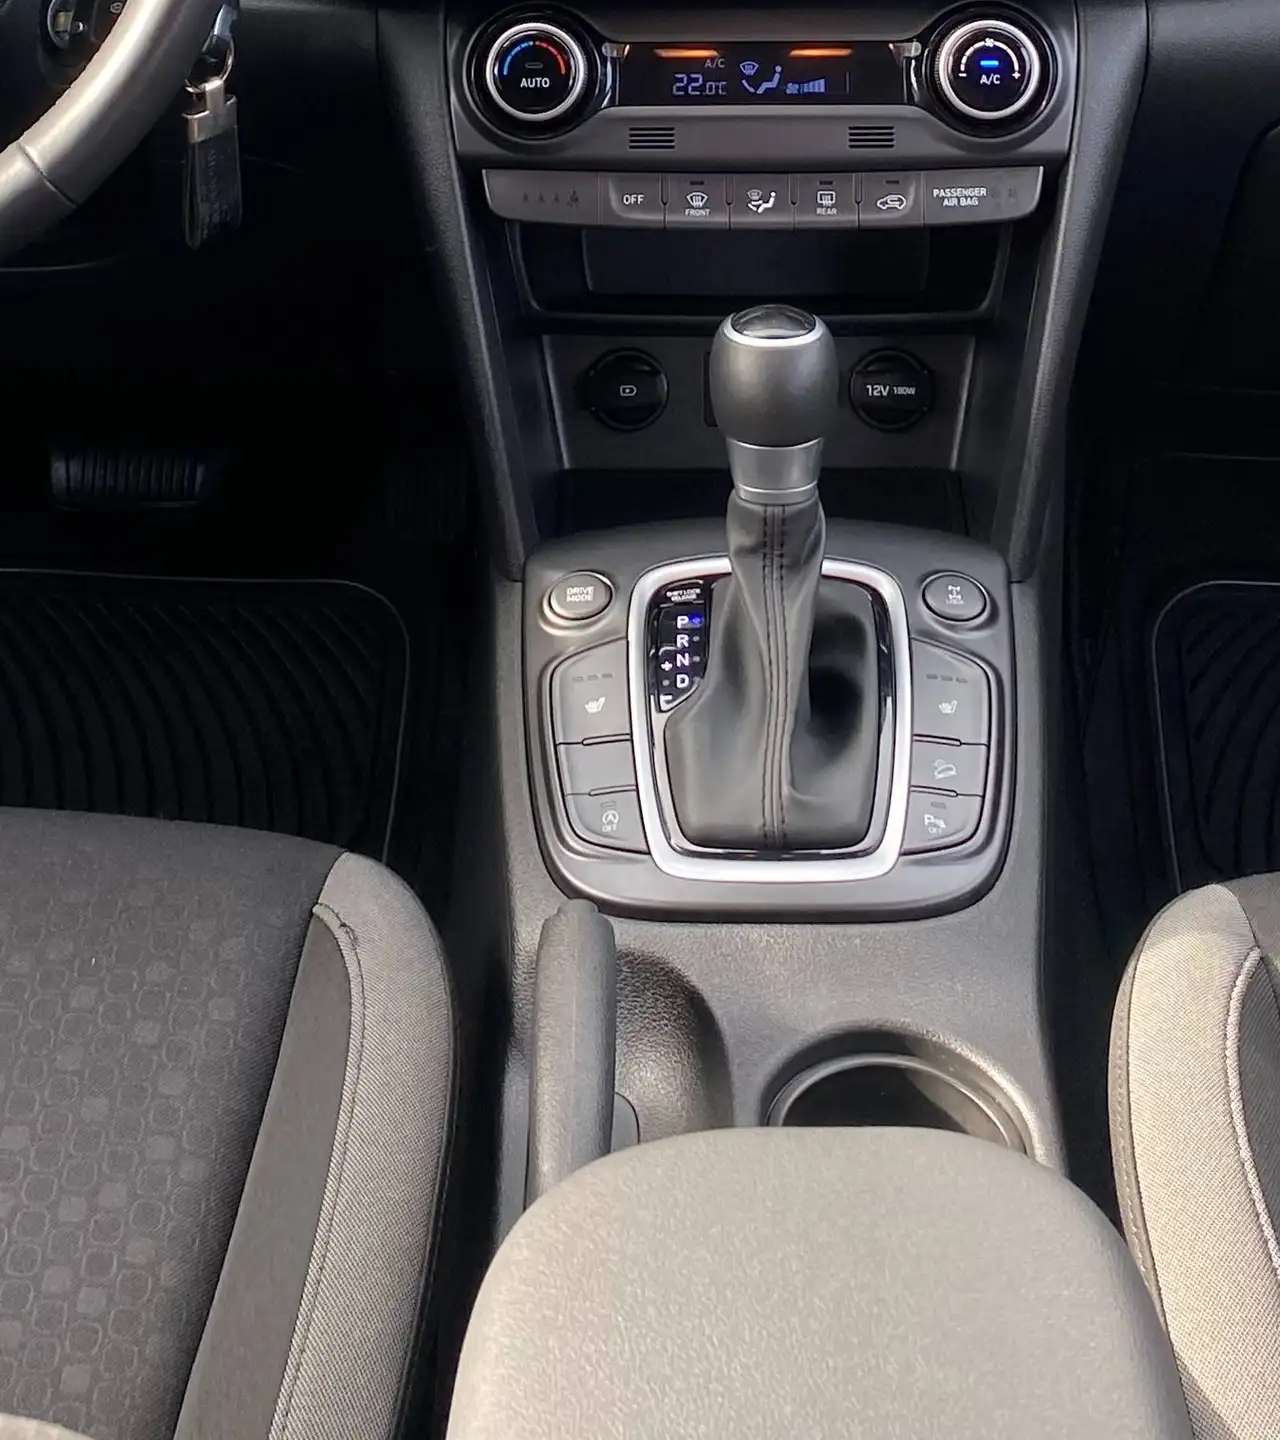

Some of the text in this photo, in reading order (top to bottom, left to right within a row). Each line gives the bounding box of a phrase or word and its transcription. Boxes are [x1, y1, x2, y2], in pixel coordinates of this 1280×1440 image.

[705, 58, 725, 68] A/C
[520, 77, 550, 88] AUTO
[980, 73, 1001, 85] A/C
[933, 187, 987, 198] PASSENGER
[623, 194, 645, 205] OFF
[959, 197, 979, 206] BAG
[685, 208, 710, 217] FRONT
[816, 207, 837, 216] REAR
[866, 384, 890, 397] 12V
[566, 586, 594, 595] DRIVE
[566, 594, 594, 602] MODE
[676, 615, 689, 629] P
[676, 634, 689, 648] R
[676, 653, 690, 667] N
[676, 674, 690, 689] D
